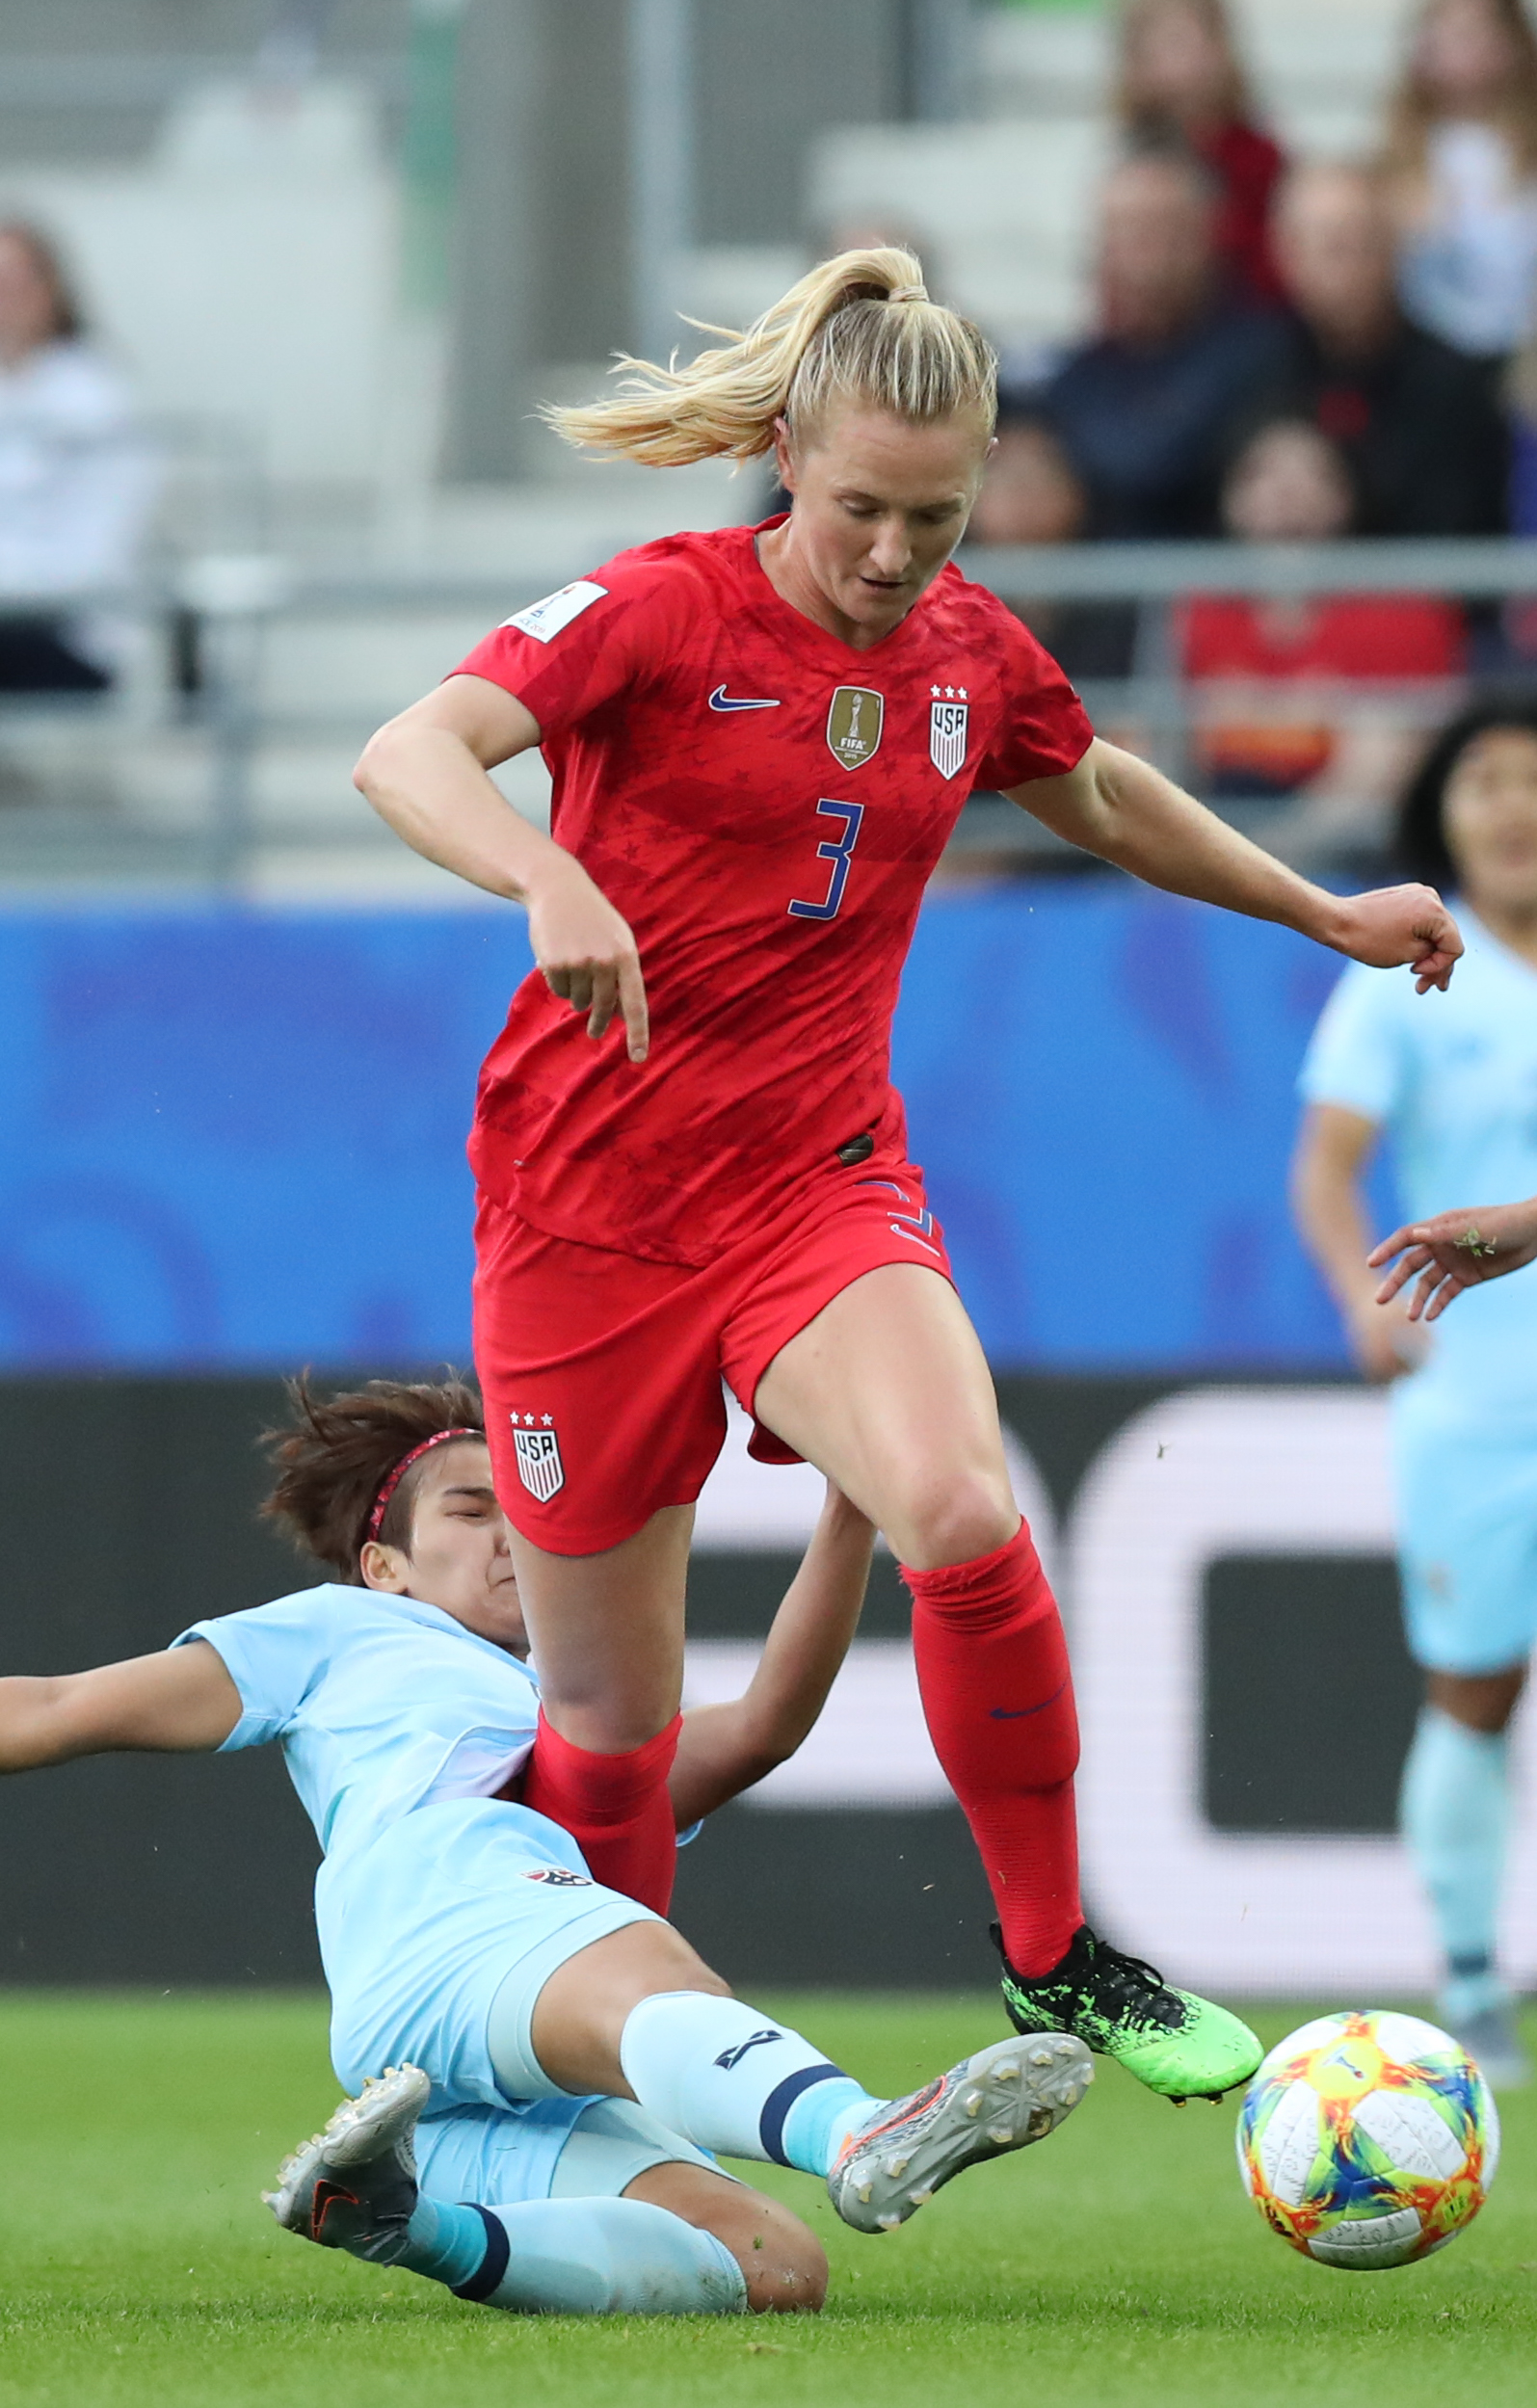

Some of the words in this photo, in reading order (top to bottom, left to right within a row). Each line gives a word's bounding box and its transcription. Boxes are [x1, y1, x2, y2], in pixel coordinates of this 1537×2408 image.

[934, 706, 965, 735] USA
[787, 798, 864, 920] 3
[516, 1434, 554, 1462] USA
